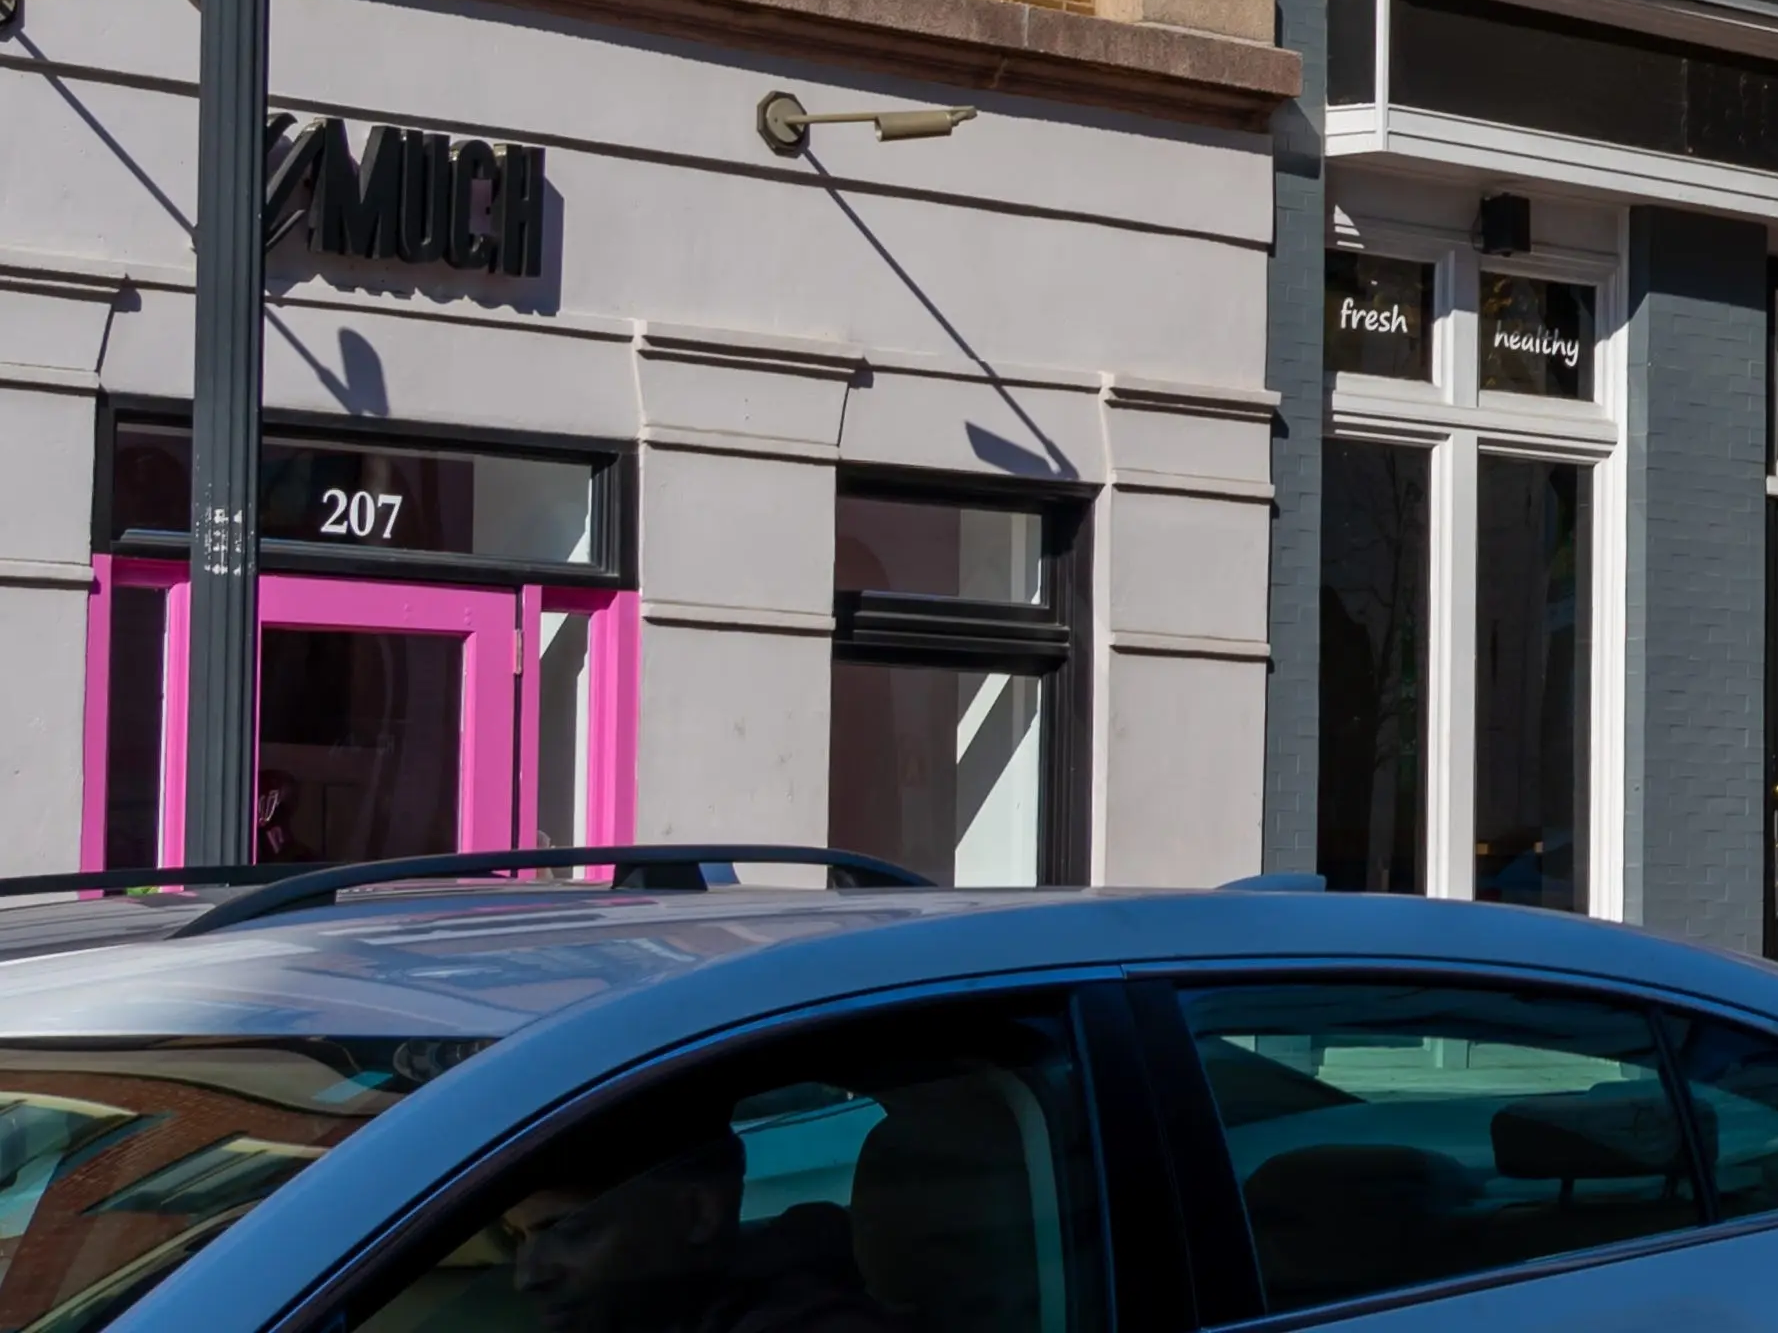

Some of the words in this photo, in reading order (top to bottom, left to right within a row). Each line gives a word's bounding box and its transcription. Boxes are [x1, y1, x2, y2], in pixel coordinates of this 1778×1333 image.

[308, 117, 546, 278] MUCH
[1340, 296, 1408, 333] fresh
[1494, 319, 1580, 367] healthy
[320, 487, 403, 539] 207
